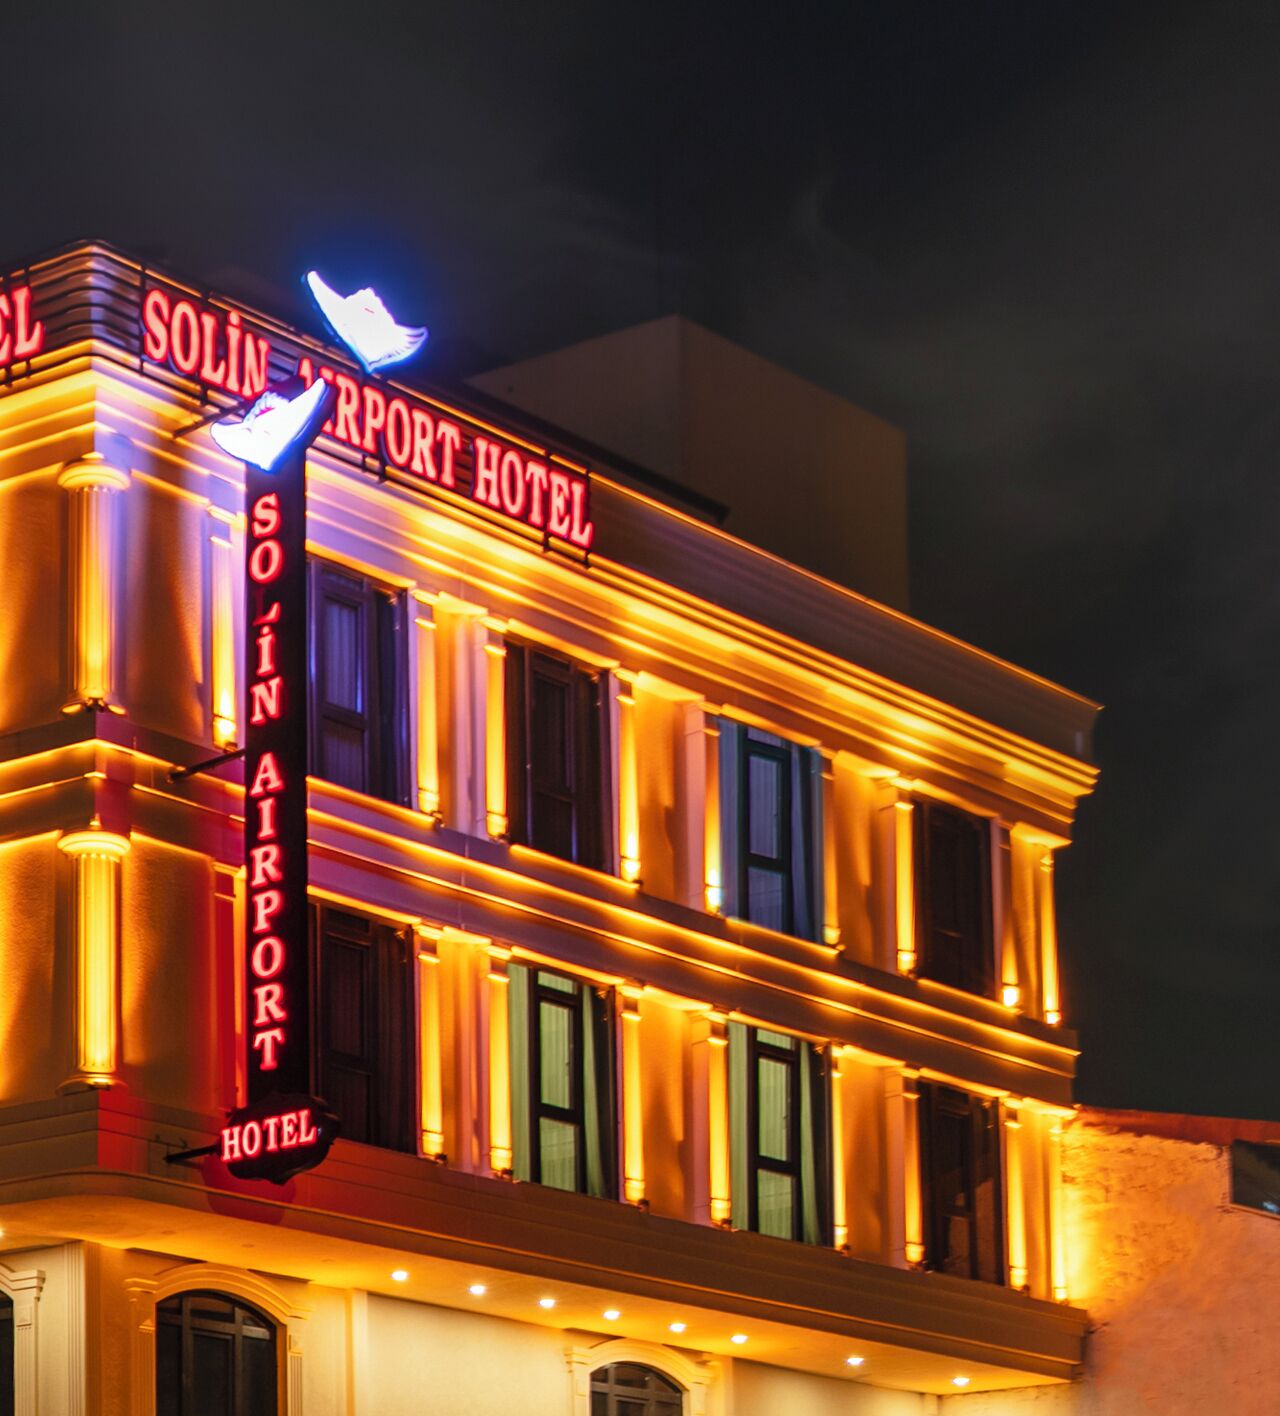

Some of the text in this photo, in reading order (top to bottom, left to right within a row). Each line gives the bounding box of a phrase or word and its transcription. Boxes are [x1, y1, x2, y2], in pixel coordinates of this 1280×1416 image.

[142, 288, 594, 548] SOLİN RPORT HOTEL
[249, 751, 287, 1070] AIRPORT
[220, 1108, 320, 1163] HOTEL
